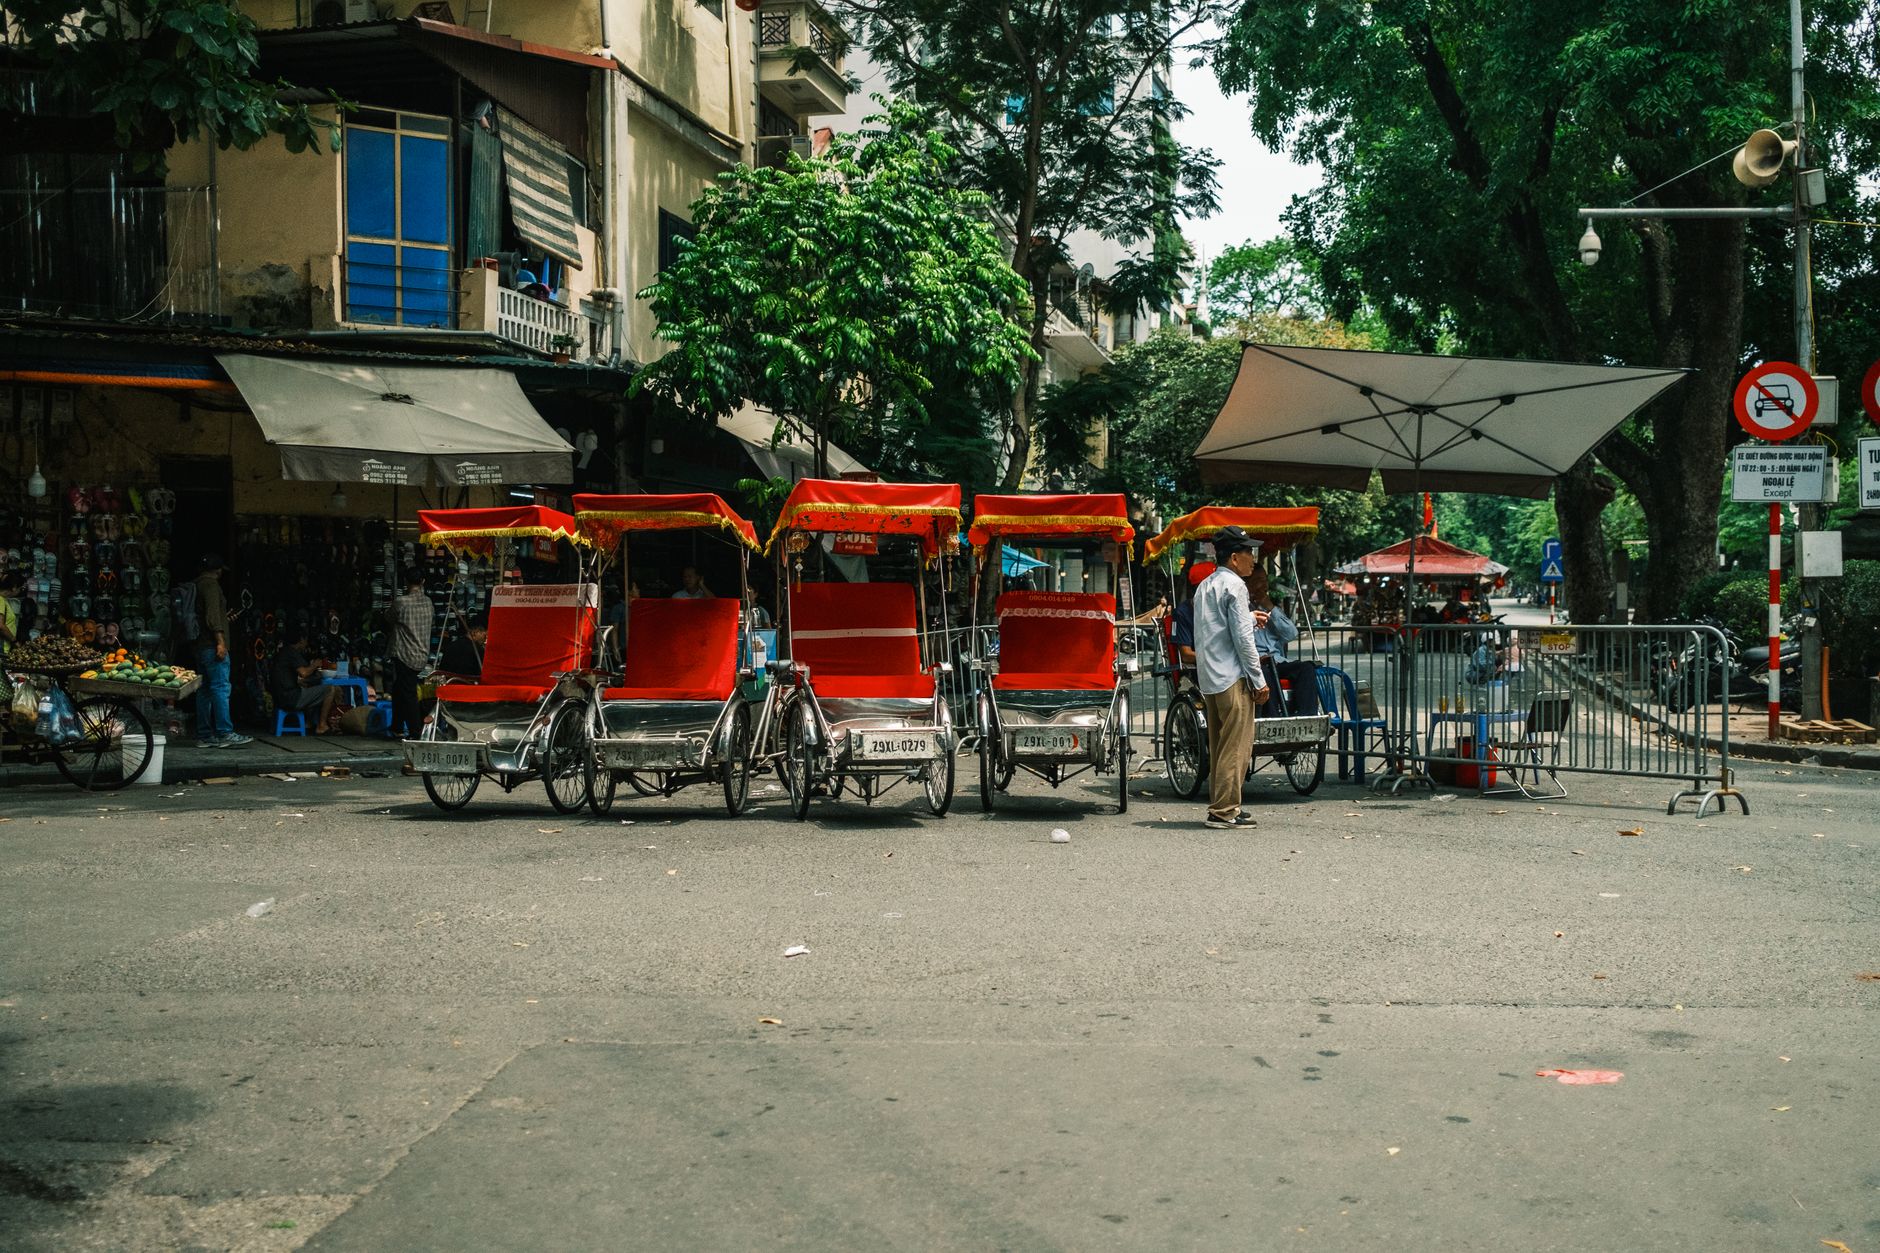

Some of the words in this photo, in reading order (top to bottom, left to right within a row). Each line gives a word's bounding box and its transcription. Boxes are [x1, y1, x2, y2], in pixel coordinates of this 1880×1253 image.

[1762, 477, 1785, 488] NGOẠI
[1786, 475, 1795, 488] LỆ
[1763, 489, 1792, 498] Except
[1023, 735, 1077, 748] 29XL-001
